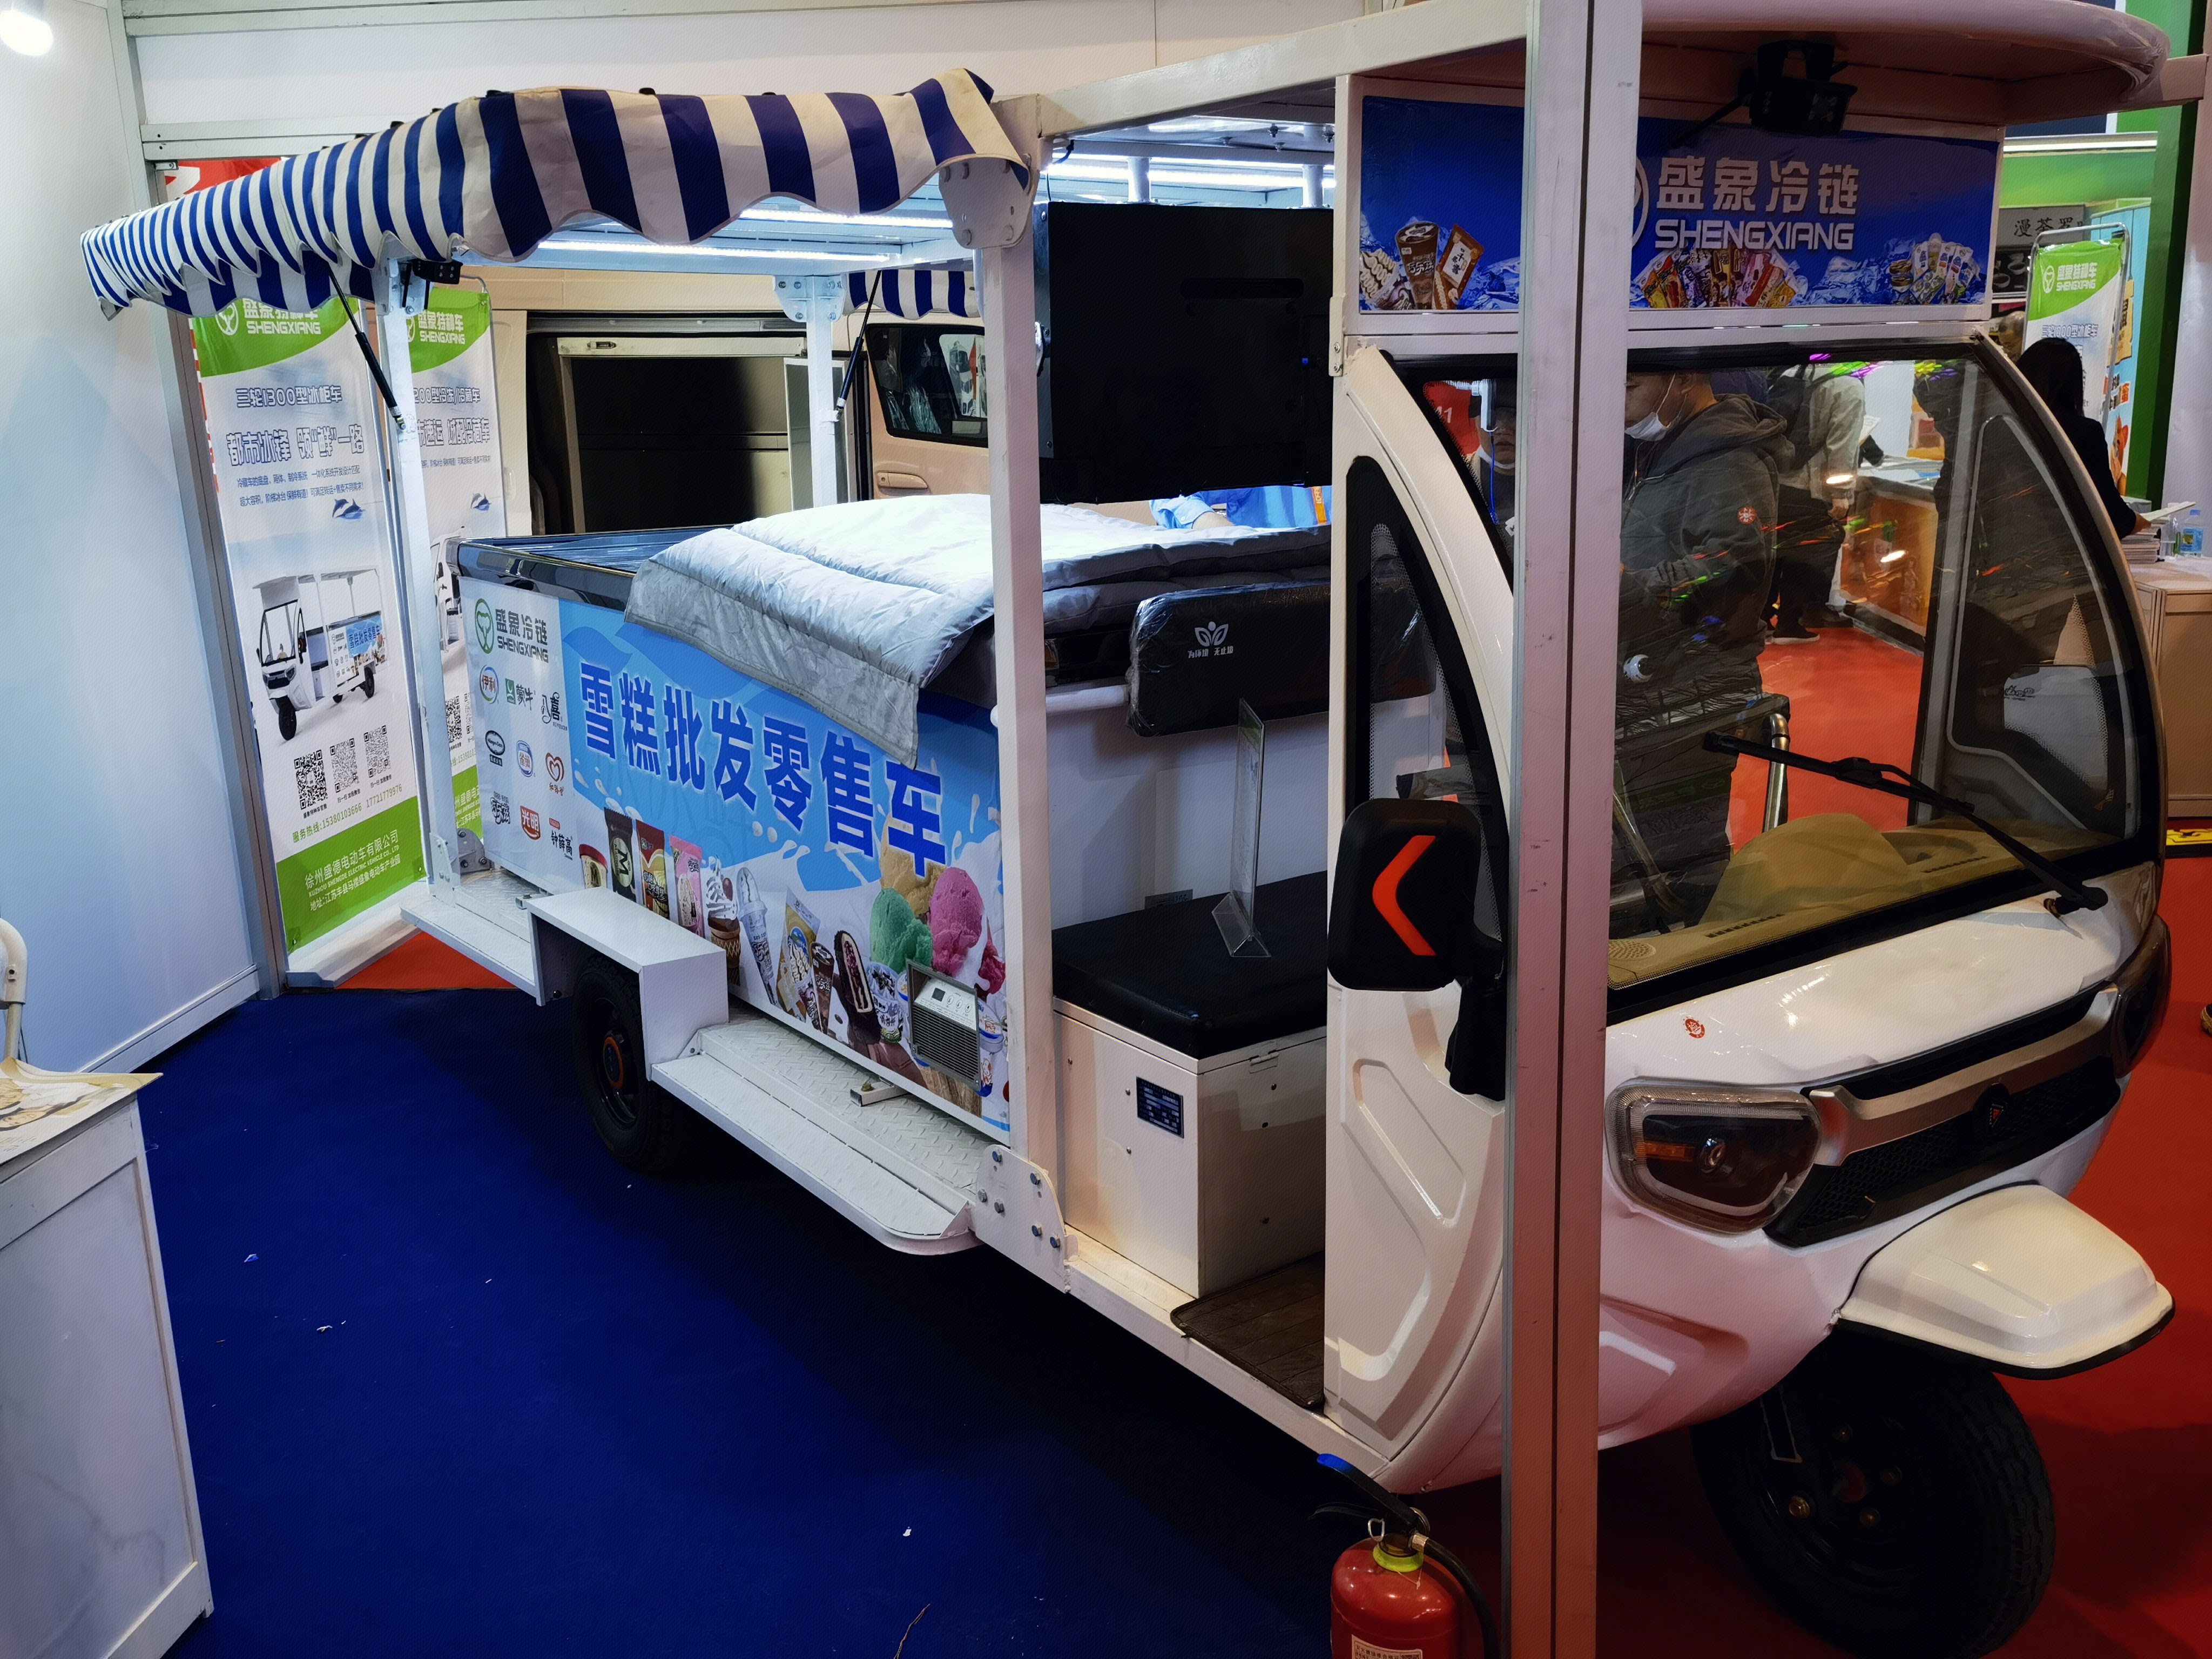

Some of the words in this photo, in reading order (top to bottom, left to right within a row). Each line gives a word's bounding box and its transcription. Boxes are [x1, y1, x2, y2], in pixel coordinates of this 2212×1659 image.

[1656, 154, 1860, 215] 盛象冷链
[1654, 219, 1854, 250] SHENGXIANG
[247, 320, 321, 335] SHENGXIANG
[420, 330, 465, 345] SHENGXIANG
[235, 385, 342, 408] 三轮1300型冰柜车
[226, 430, 291, 466] 都市冰锋
[496, 608, 548, 645] 盛象冷链
[497, 636, 549, 663] SHENGXIANG
[482, 675, 496, 693] 伊利
[516, 683, 533, 711] 蒙牛
[580, 662, 948, 879] 雪糕批发零售车
[366, 784, 402, 808] 17721779976
[522, 809, 539, 832] 光明
[551, 831, 572, 855] 钟薛高
[305, 830, 399, 889] 徐州盛德电动车有限公司
[308, 884, 327, 898] XUZHOU
[328, 873, 347, 889] SHENGDE
[348, 862, 367, 876] ELECTRIC
[367, 853, 383, 866] VEHICLE
